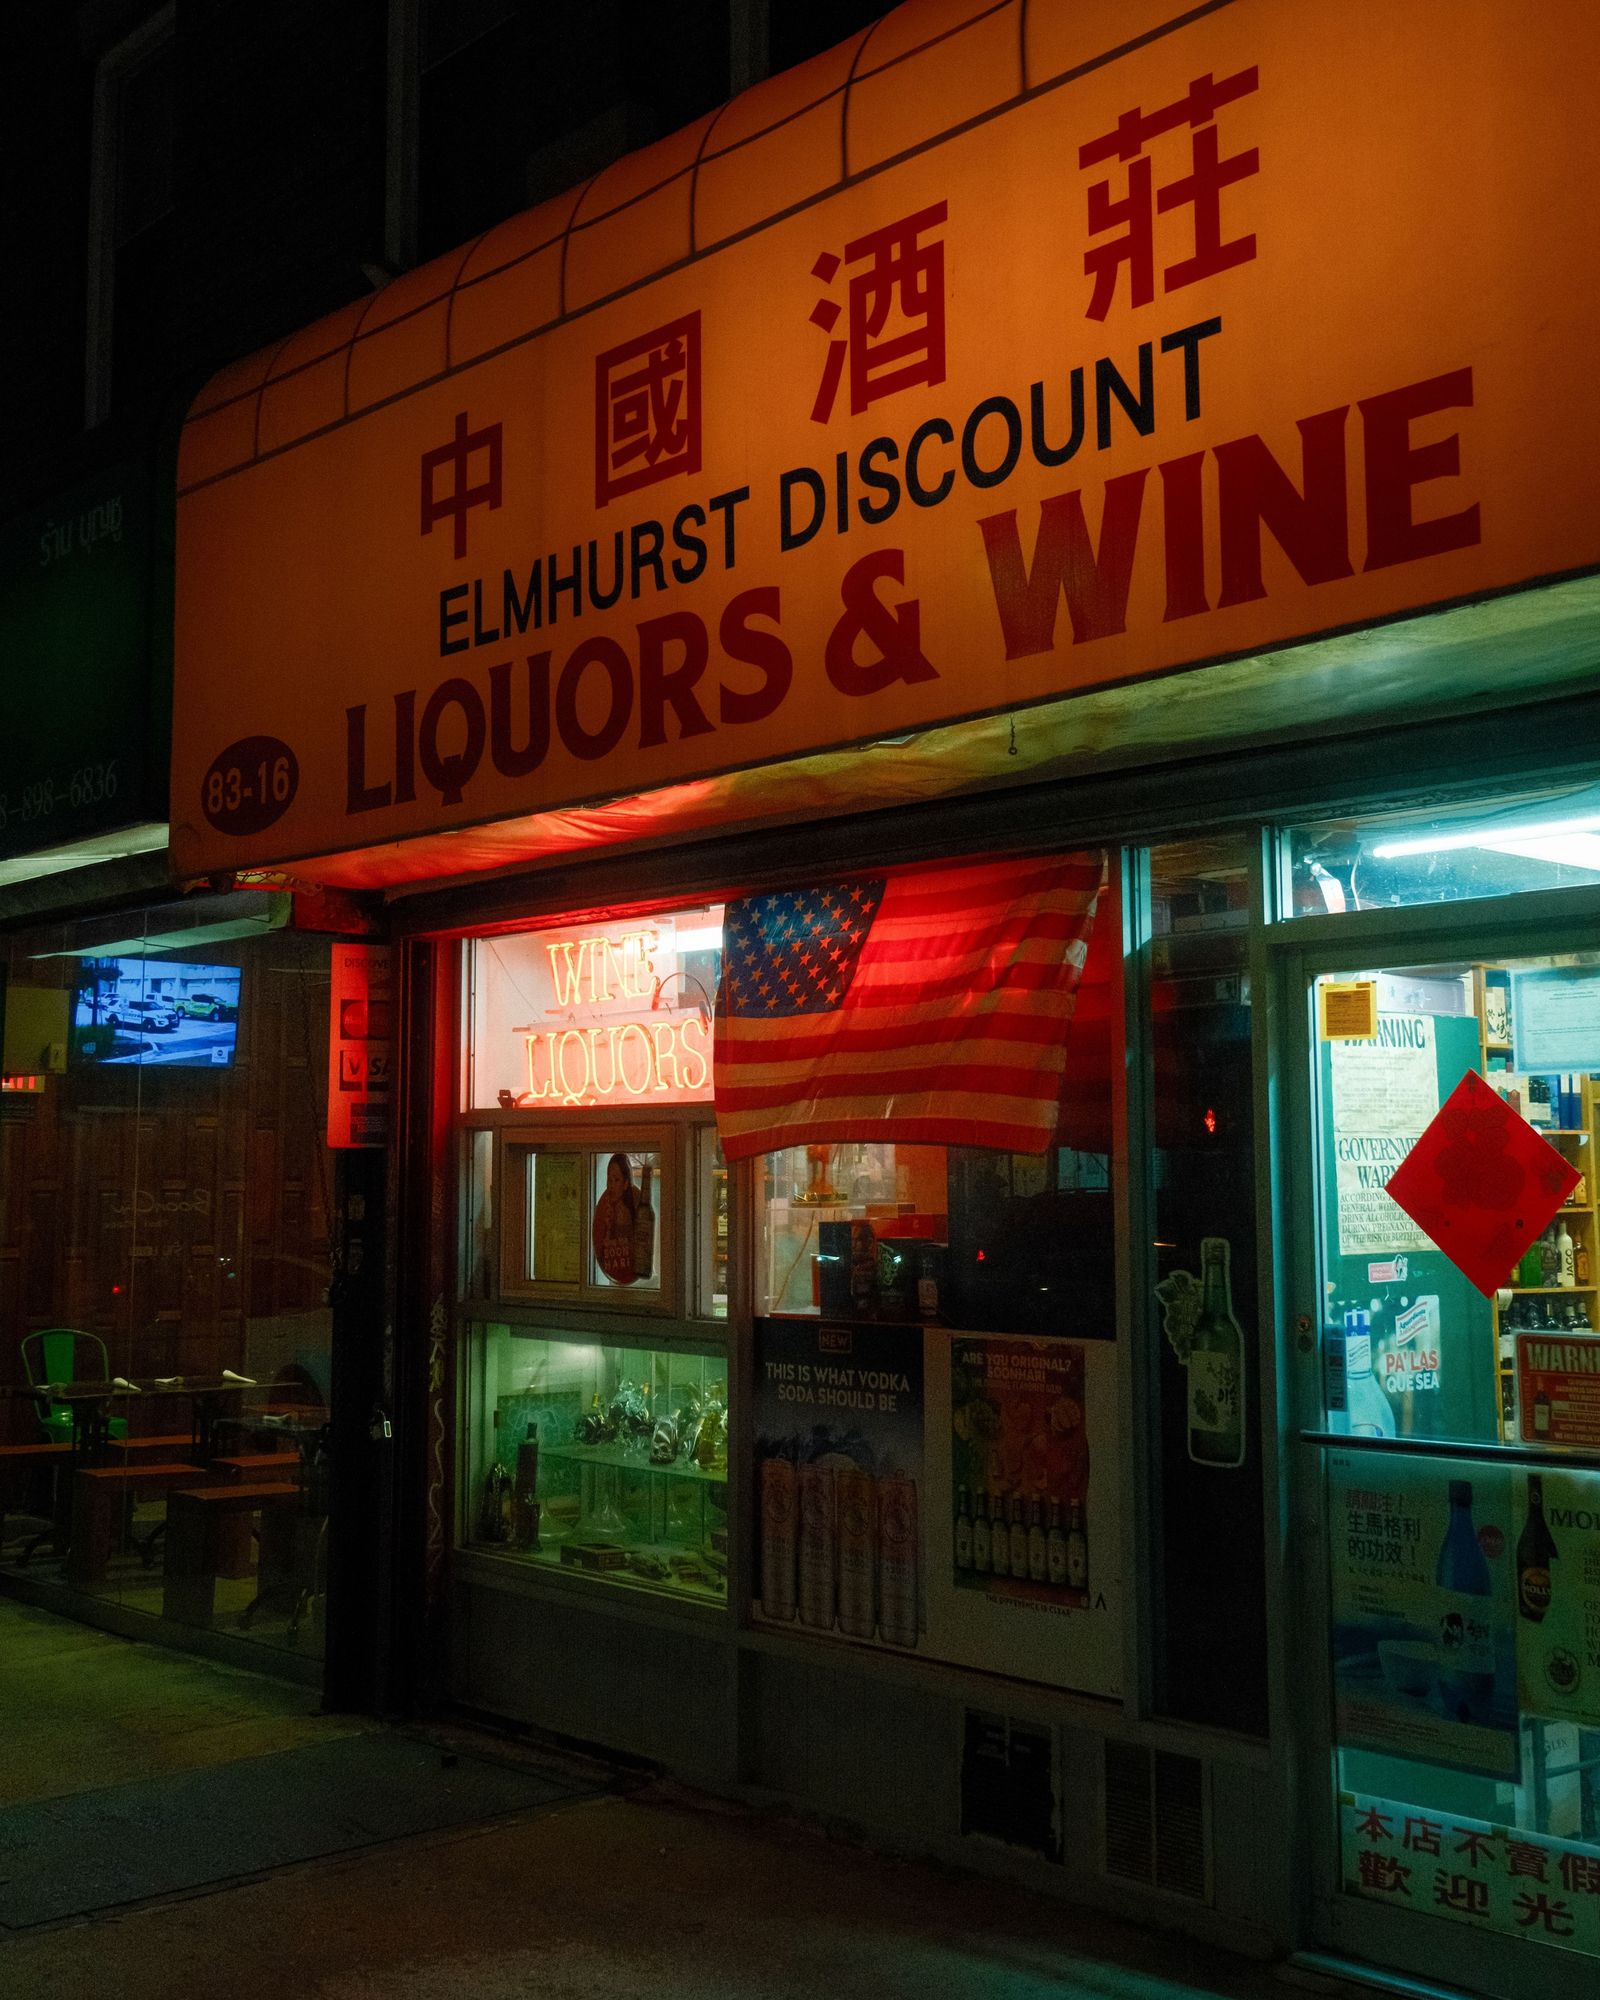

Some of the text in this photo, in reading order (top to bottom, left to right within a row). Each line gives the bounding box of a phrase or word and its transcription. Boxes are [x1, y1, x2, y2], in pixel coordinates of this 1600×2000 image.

[440, 316, 1222, 657] ELMHURST DISCOUNT
[346, 366, 1480, 815] LIQUORS & WINE
[207, 755, 290, 815] 83-16
[546, 931, 658, 1007] WINE
[525, 1018, 708, 1105] LIQUORS
[765, 1361, 911, 1394] THIS IS WHAT VODKA
[961, 1351, 1072, 1373] ARE YOU ORIGINAL?
[1386, 1372, 1440, 1393] QUE SEA
[778, 1384, 898, 1412] SODA SHOULD BE
